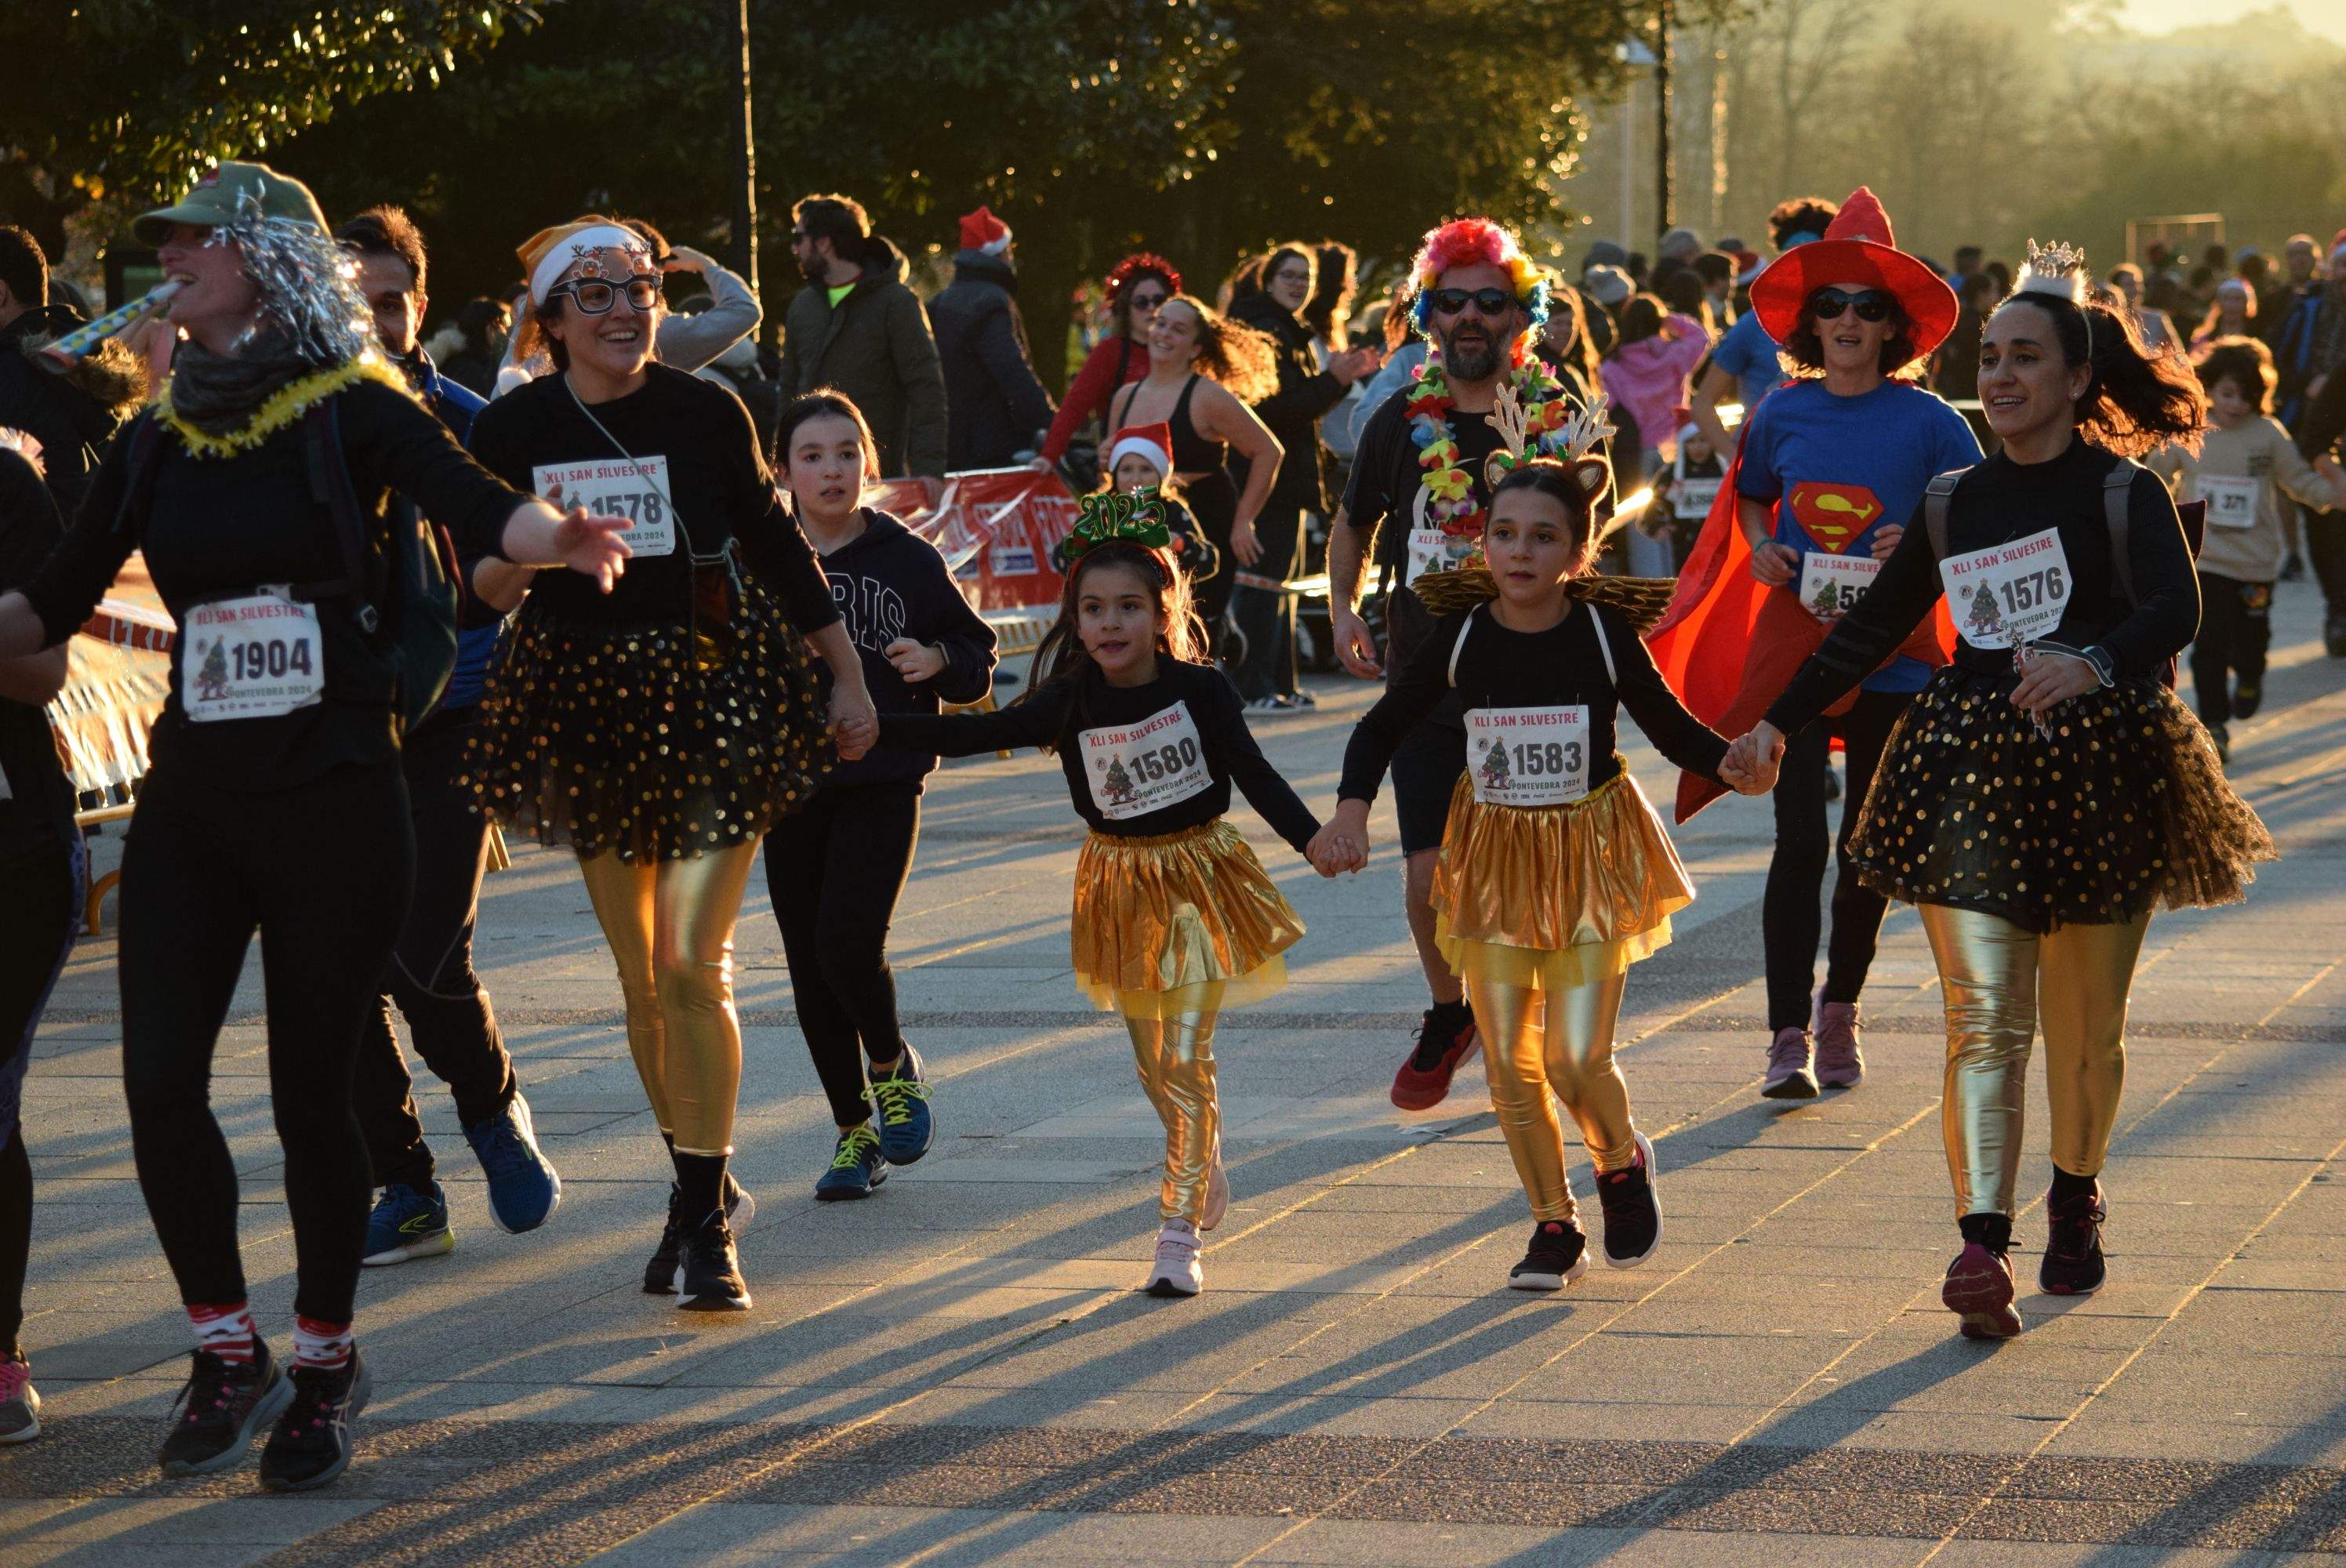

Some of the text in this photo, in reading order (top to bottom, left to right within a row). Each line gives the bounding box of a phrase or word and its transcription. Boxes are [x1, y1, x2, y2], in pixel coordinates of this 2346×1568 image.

[545, 472, 565, 484] XLI
[569, 469, 593, 481] SAN
[591, 492, 663, 526] 1578
[1072, 485, 1166, 538] 2025
[645, 532, 665, 540] 2024
[1417, 535, 1446, 545] XLI SA
[1813, 558, 1879, 573] XLI SAN SILVE
[1952, 536, 2054, 575] XLI SAN SILVESTRE
[2000, 566, 2065, 615] 1576
[196, 604, 307, 626] XLI SAN SILVESTRE
[2004, 611, 2049, 630] PONTEVEDRA
[232, 638, 312, 681] 1904
[288, 685, 312, 695] 2024
[1090, 710, 1182, 747] XLI SAN SILVESTRE
[1474, 712, 1578, 728] XLI SAN SILVESTRE
[1130, 736, 1197, 784] 1580
[1512, 741, 1582, 775] 1583
[1138, 779, 1184, 799] PONTEVEDRA
[1185, 769, 1201, 782] 2024
[1512, 778, 1581, 790] PONTEVEDRA 2024
